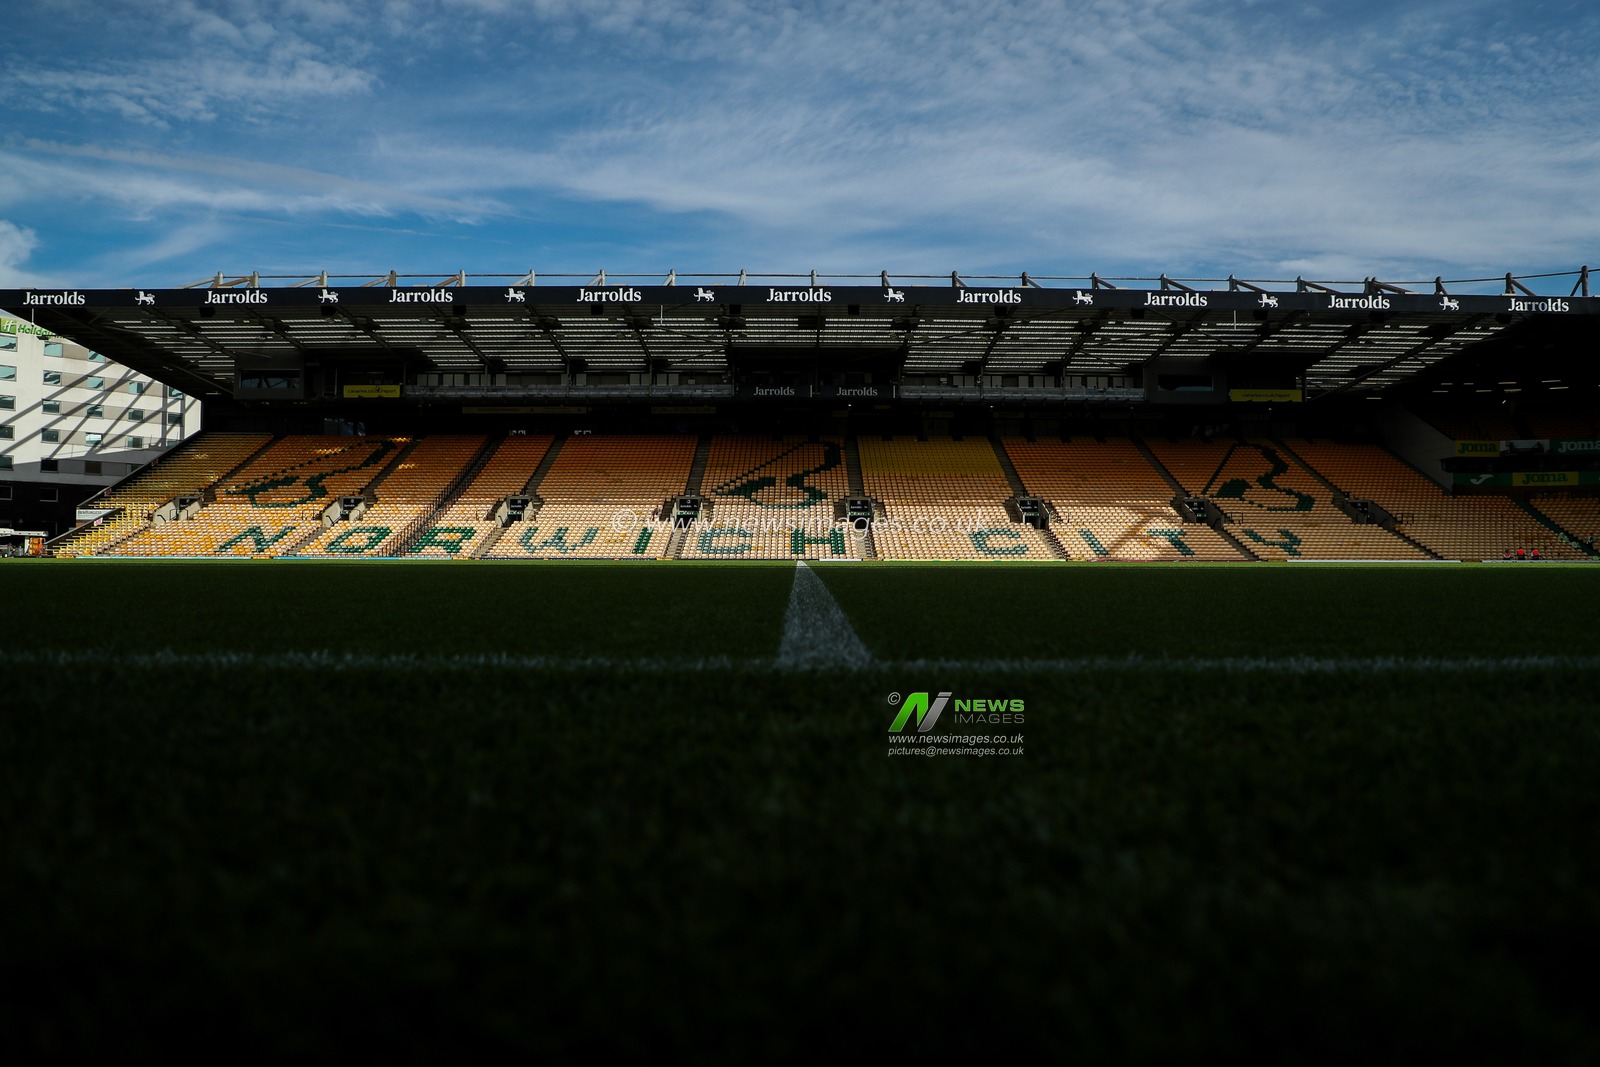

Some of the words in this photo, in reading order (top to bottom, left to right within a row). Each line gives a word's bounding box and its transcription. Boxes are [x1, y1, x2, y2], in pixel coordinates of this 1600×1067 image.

[23, 292, 86, 305] Jarrolds
[204, 290, 268, 304] Jarrolds
[388, 289, 454, 303] Jarrolds
[576, 288, 642, 302] Jarrolds
[766, 288, 832, 302] Jarrolds
[956, 290, 1022, 304] Jarrolds
[1143, 293, 1208, 307] Jarrolds
[1327, 295, 1391, 309] Jarrolds
[1507, 299, 1570, 312] Jarrolds
[753, 386, 795, 397] Jarrolds
[836, 387, 878, 398] Jarrolds
